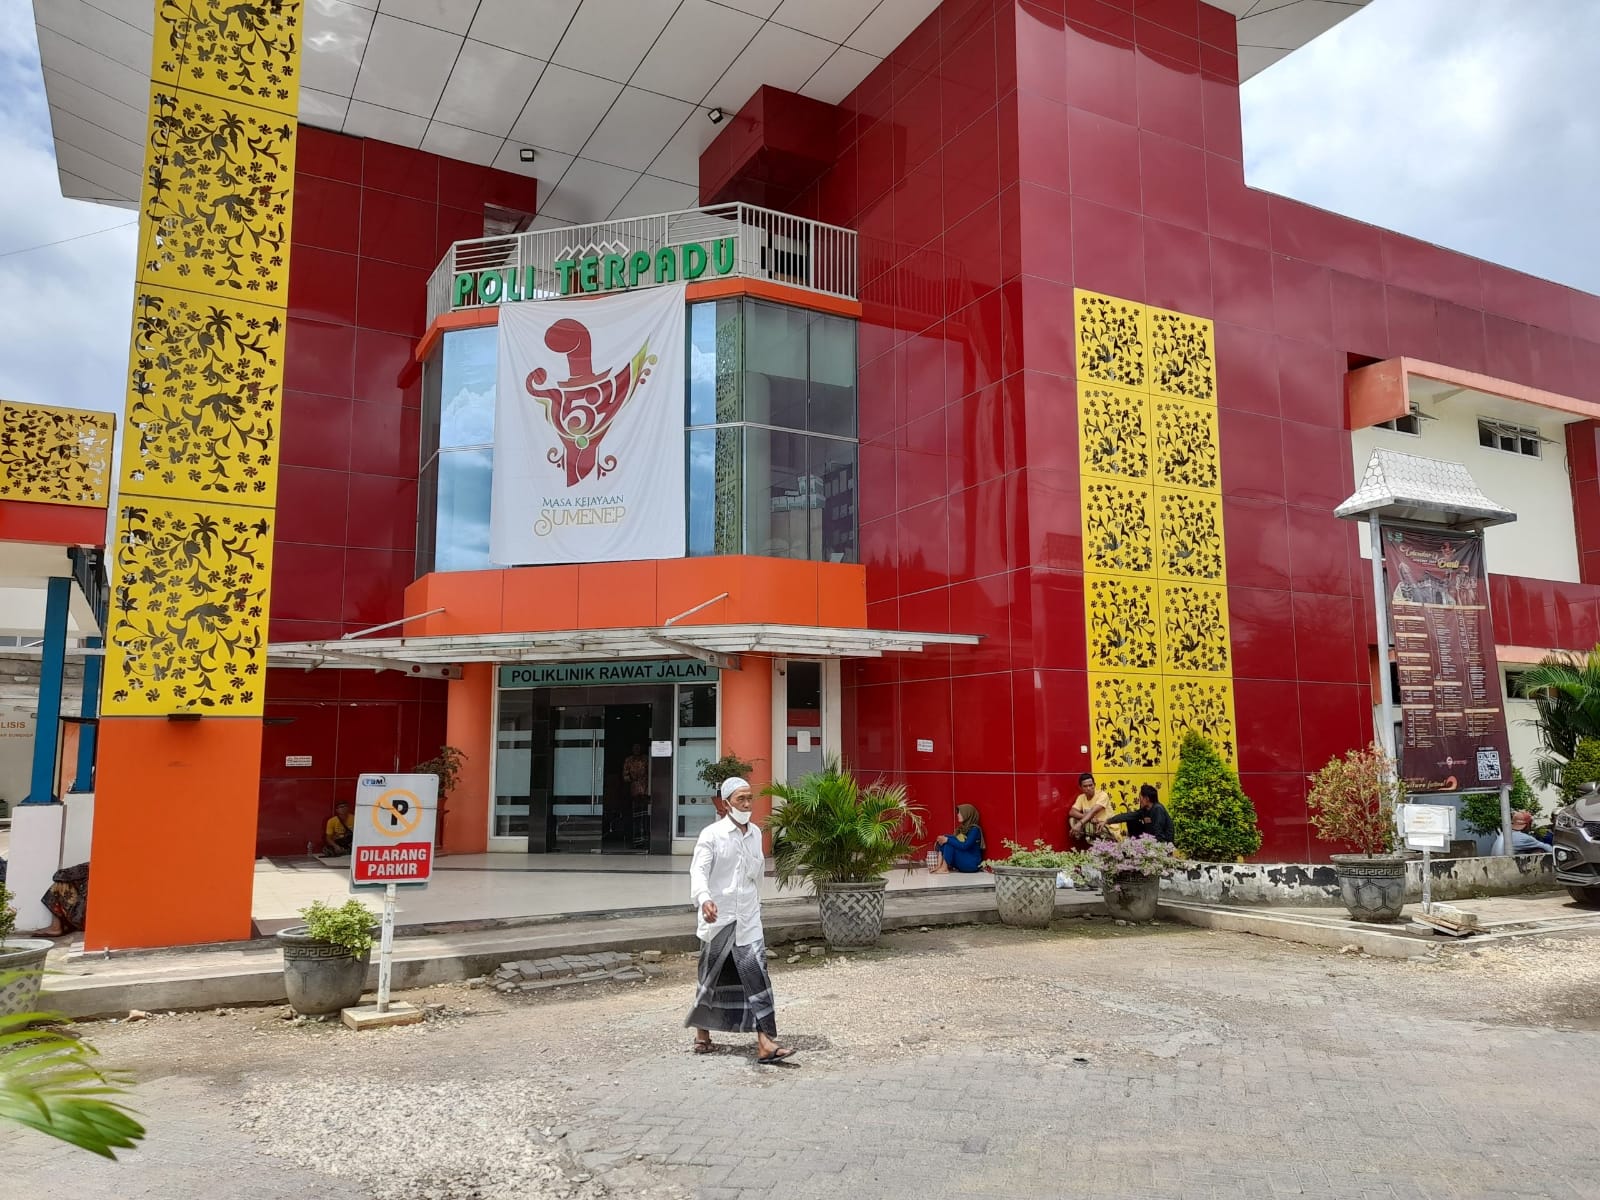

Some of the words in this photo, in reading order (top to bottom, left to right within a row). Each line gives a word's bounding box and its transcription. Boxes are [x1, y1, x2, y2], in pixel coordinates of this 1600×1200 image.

[454, 265, 534, 306] POLI
[555, 238, 734, 294] TERPADU
[542, 496, 572, 508] MASA
[574, 494, 625, 508] KEJAYAAN
[533, 505, 626, 537] SUMENEP
[512, 667, 594, 682] POLIKLINIK
[600, 665, 653, 680] RAWAT
[657, 664, 707, 677] JALAN
[360, 849, 426, 861] DILARANG
[368, 863, 417, 876] PARKIR
